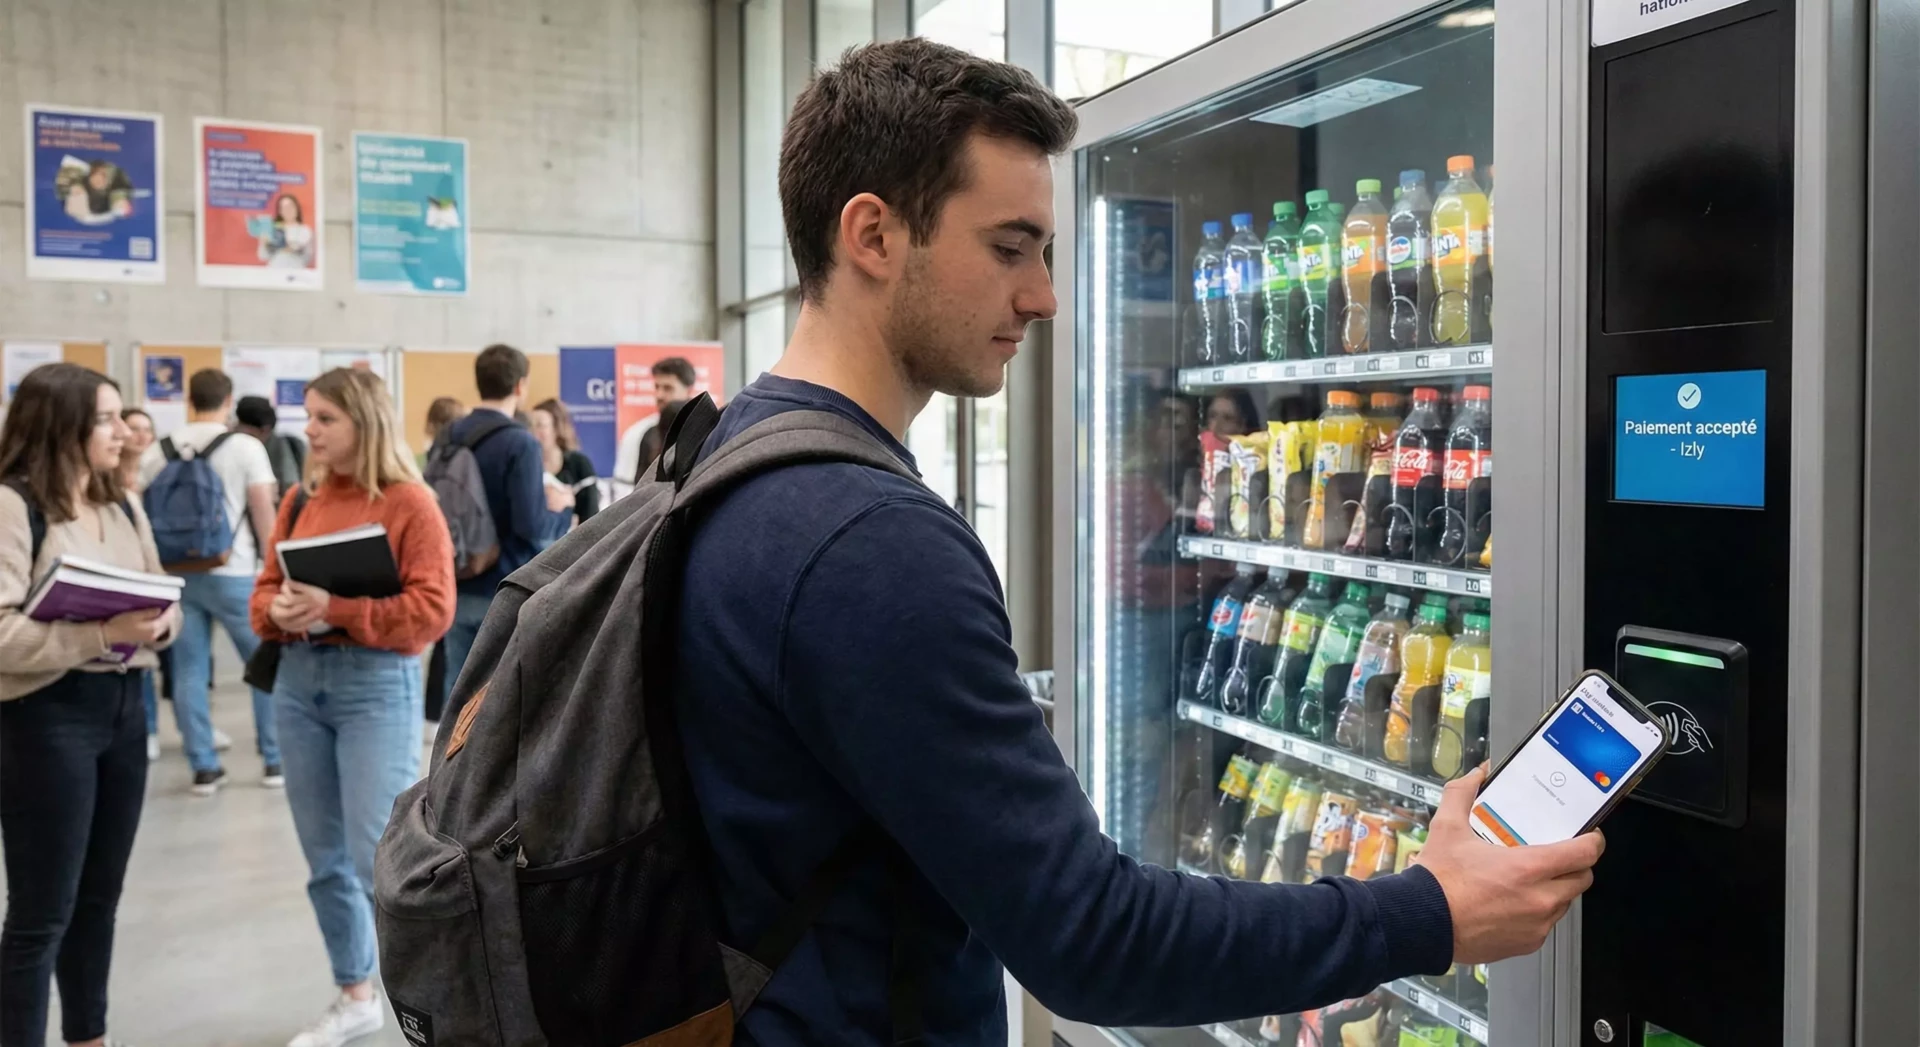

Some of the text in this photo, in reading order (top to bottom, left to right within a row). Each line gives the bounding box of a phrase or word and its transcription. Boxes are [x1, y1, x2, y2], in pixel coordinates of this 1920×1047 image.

[1625, 418, 1757, 438] Paiement accepté
[1680, 441, 1705, 460] Izly
